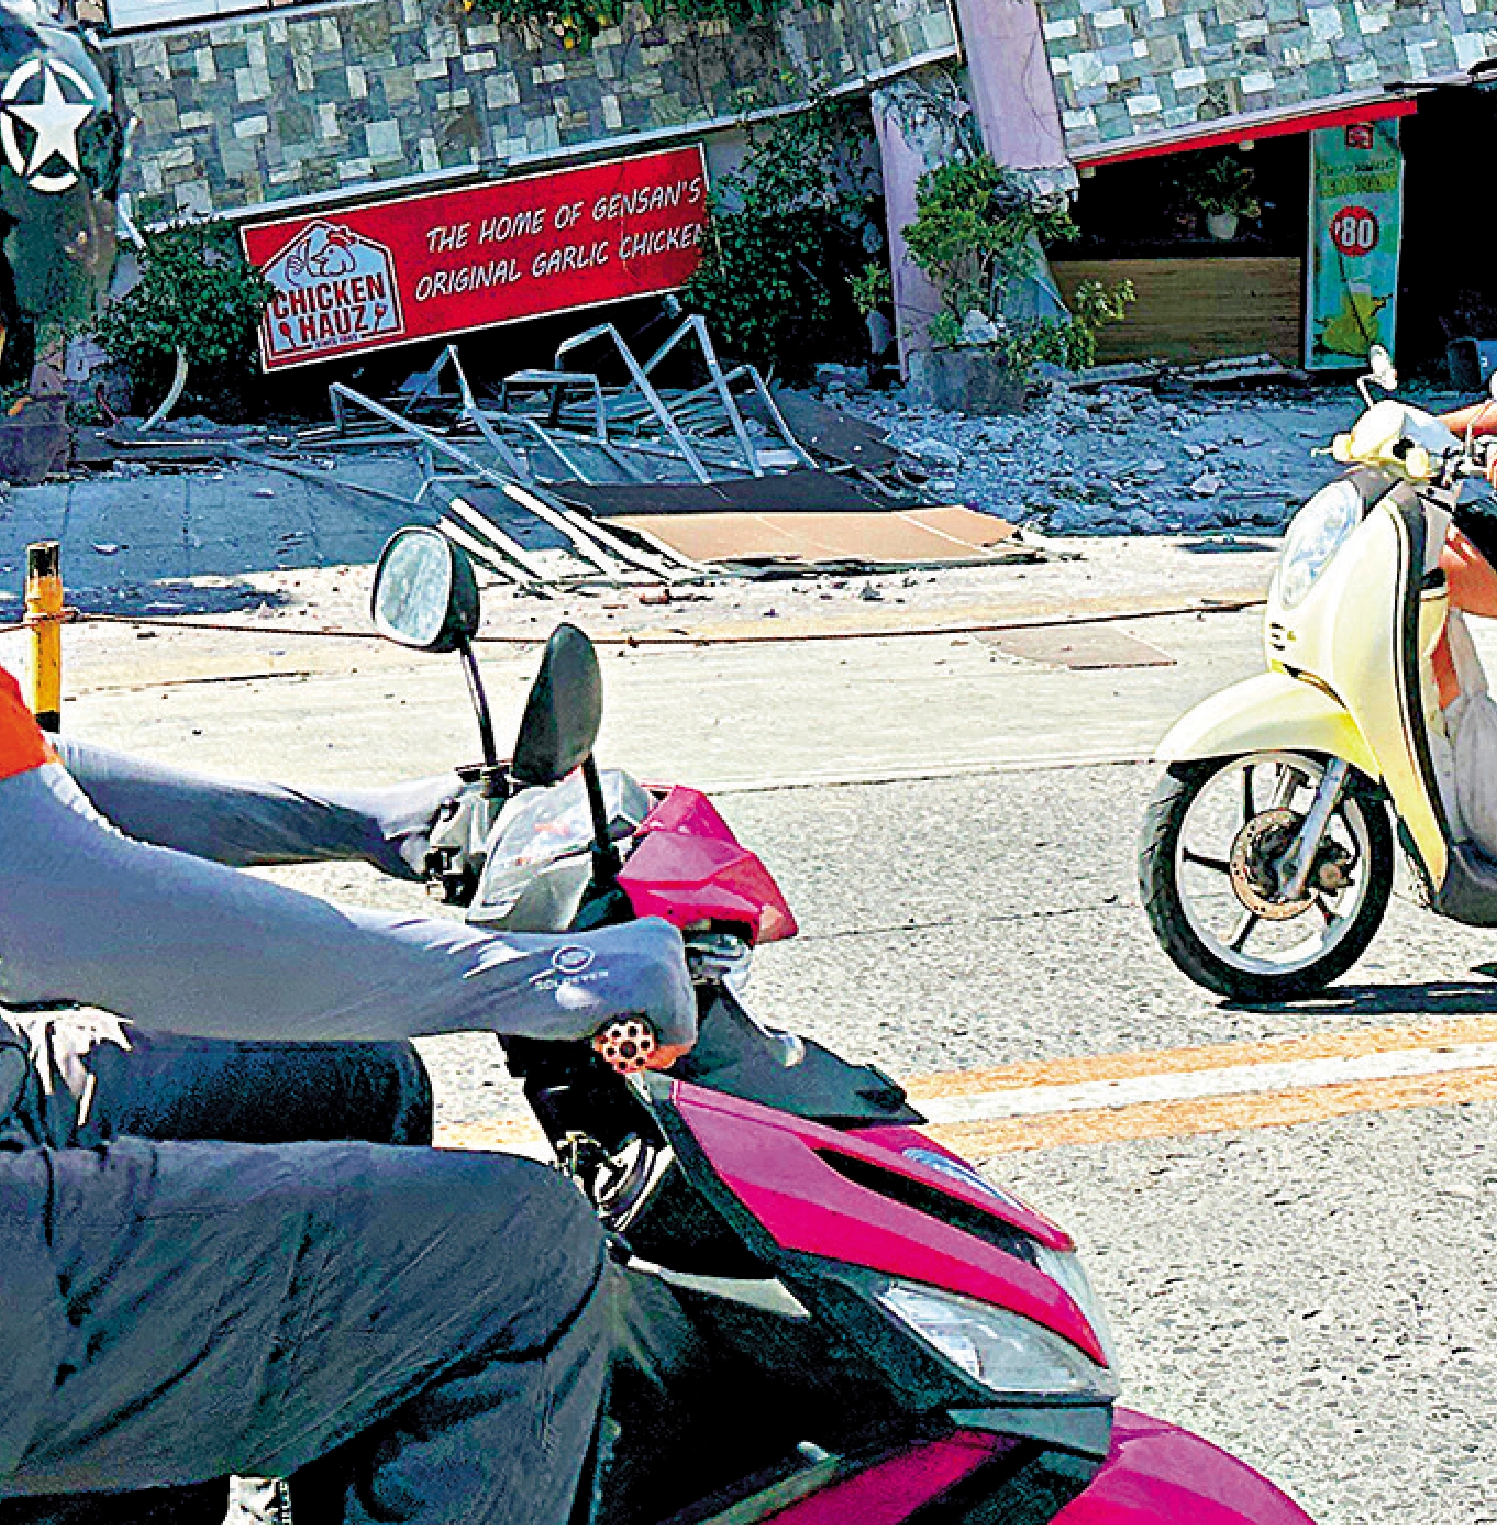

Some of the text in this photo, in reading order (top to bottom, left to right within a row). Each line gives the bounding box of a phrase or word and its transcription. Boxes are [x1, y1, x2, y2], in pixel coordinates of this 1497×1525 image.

[427, 177, 701, 252] THE HOME OF GENSAN'S
[273, 272, 385, 318] CHICKEN
[415, 259, 521, 301] ORIGINAL
[533, 241, 609, 277] GARLIC
[298, 304, 369, 343] HAUZ
